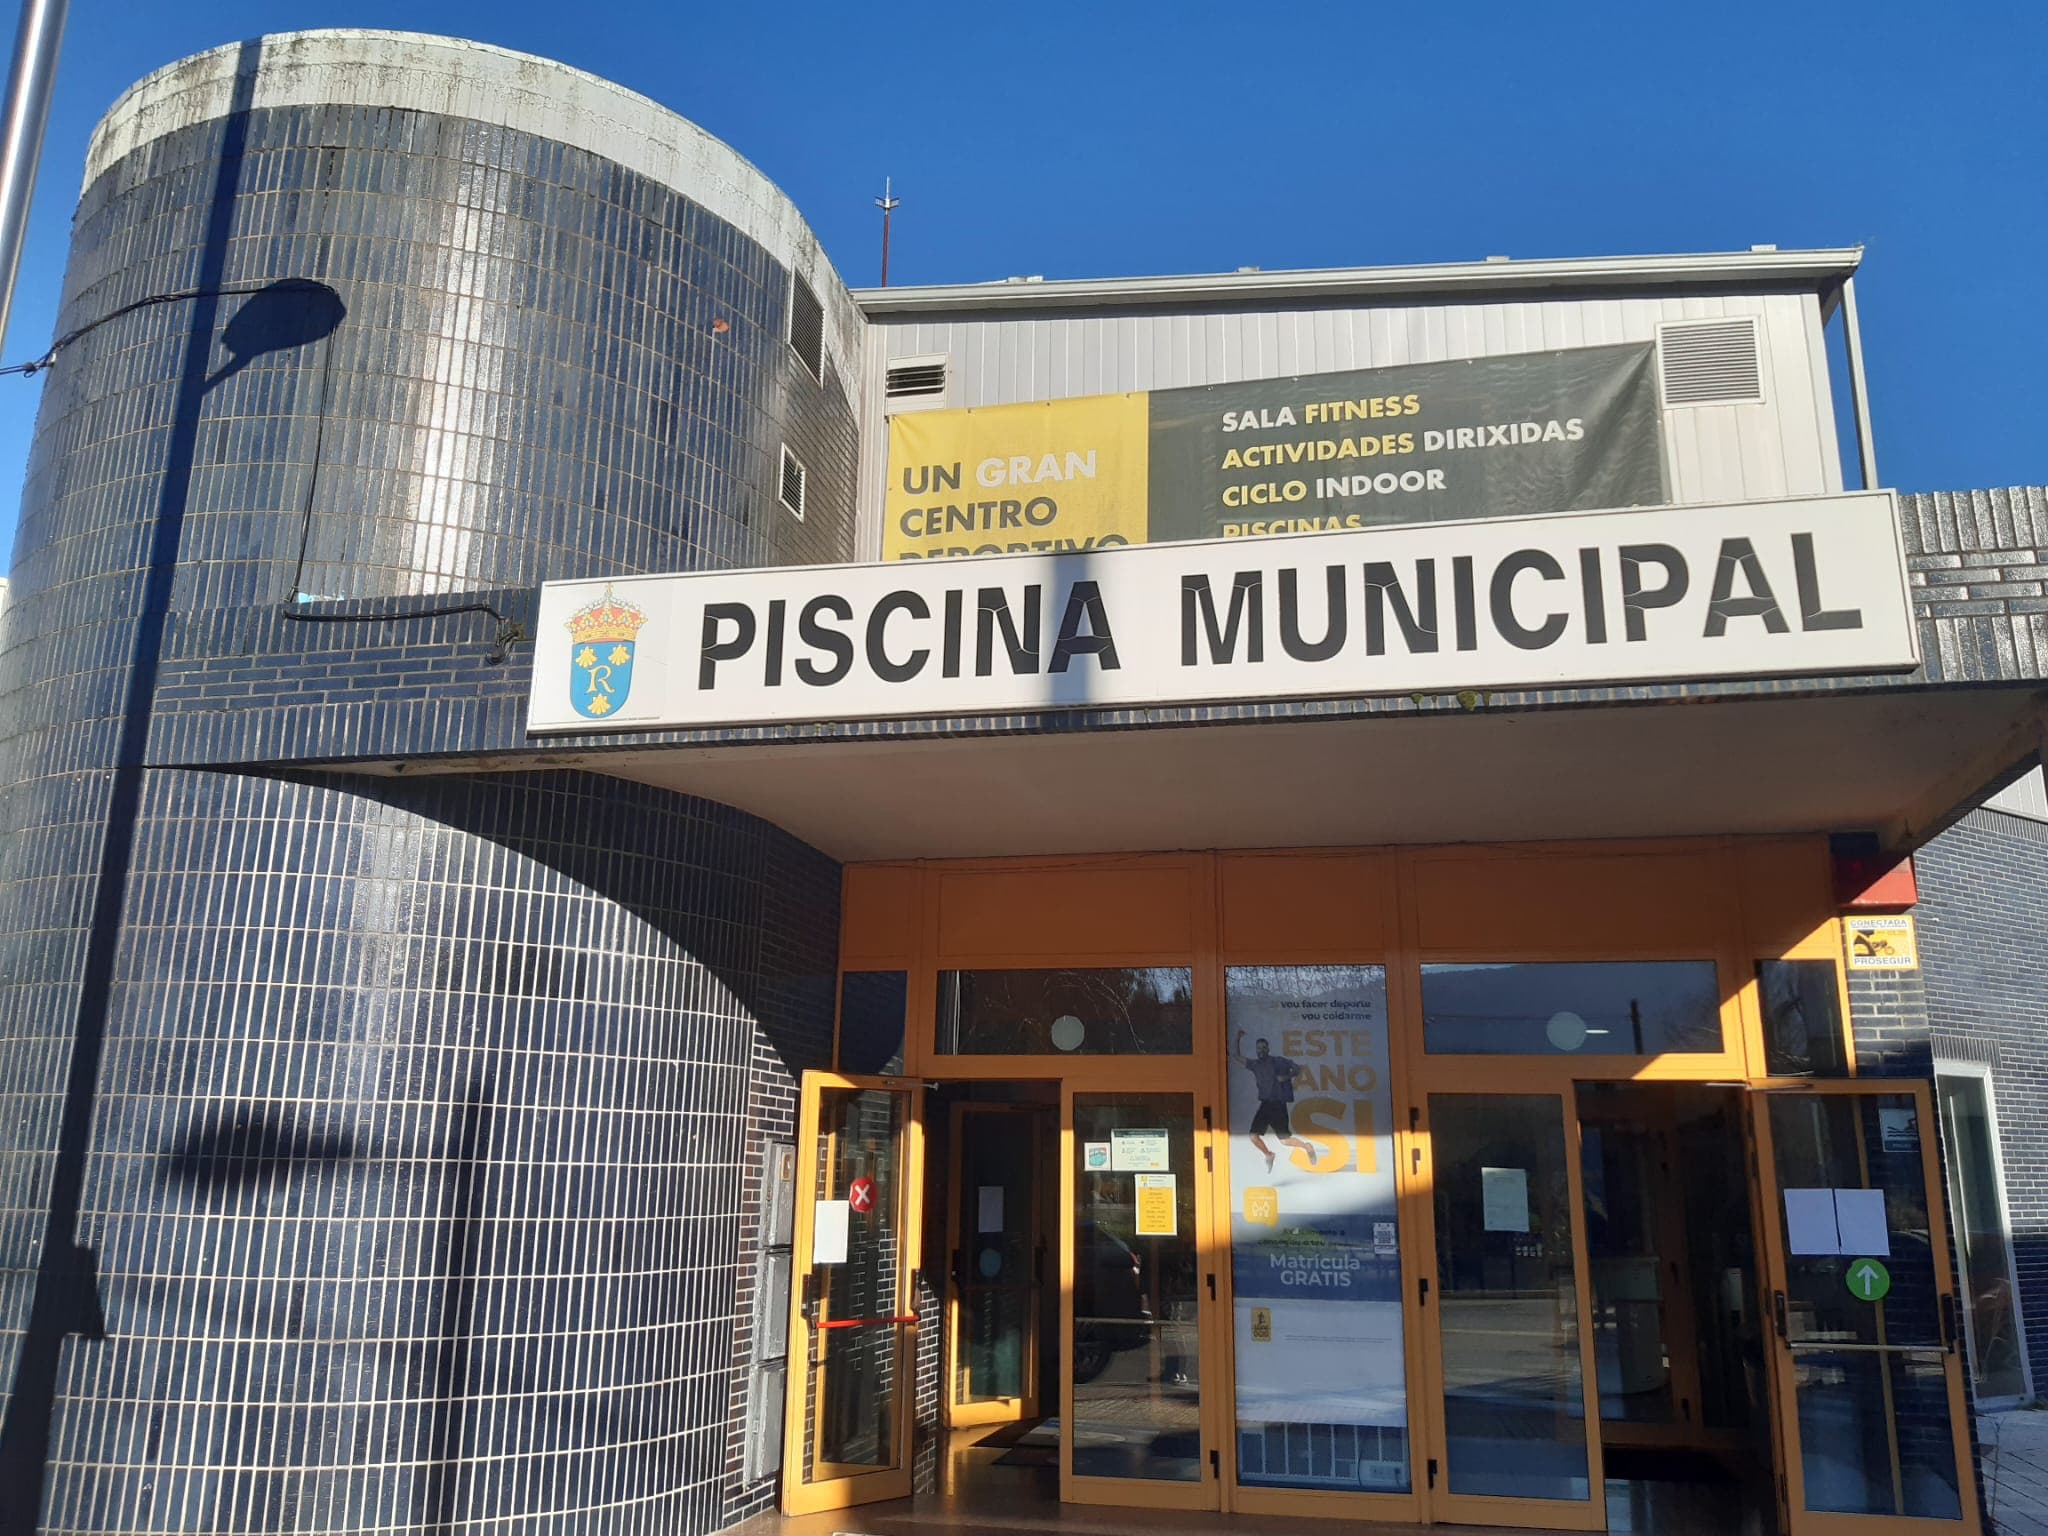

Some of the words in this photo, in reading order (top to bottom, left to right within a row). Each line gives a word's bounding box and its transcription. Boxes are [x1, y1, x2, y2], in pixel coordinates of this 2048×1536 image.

[1222, 406, 1297, 432] SALA
[1305, 394, 1420, 424] FITNESS
[1221, 433, 1415, 469] ACTIVIDADES
[1423, 418, 1585, 452] DIRIXIDAS
[903, 462, 962, 495] UN
[975, 449, 1097, 488] GRAN
[1222, 480, 1308, 507] CICLO
[1316, 469, 1447, 499] INDOOR
[899, 496, 1058, 538] CENTRO
[697, 580, 1121, 690] PISCINA
[1180, 532, 1863, 666] MUNICIPAL
[586, 665, 615, 694] R
[1850, 919, 1908, 927] CONECTADA
[1854, 957, 1911, 965] PROSEGUR
[1282, 1029, 1374, 1057] ESTE
[1293, 1063, 1377, 1092] ANO
[1288, 1096, 1377, 1174] SI
[1269, 1253, 1361, 1270] Matrícula
[1280, 1270, 1352, 1287] GRATIS
